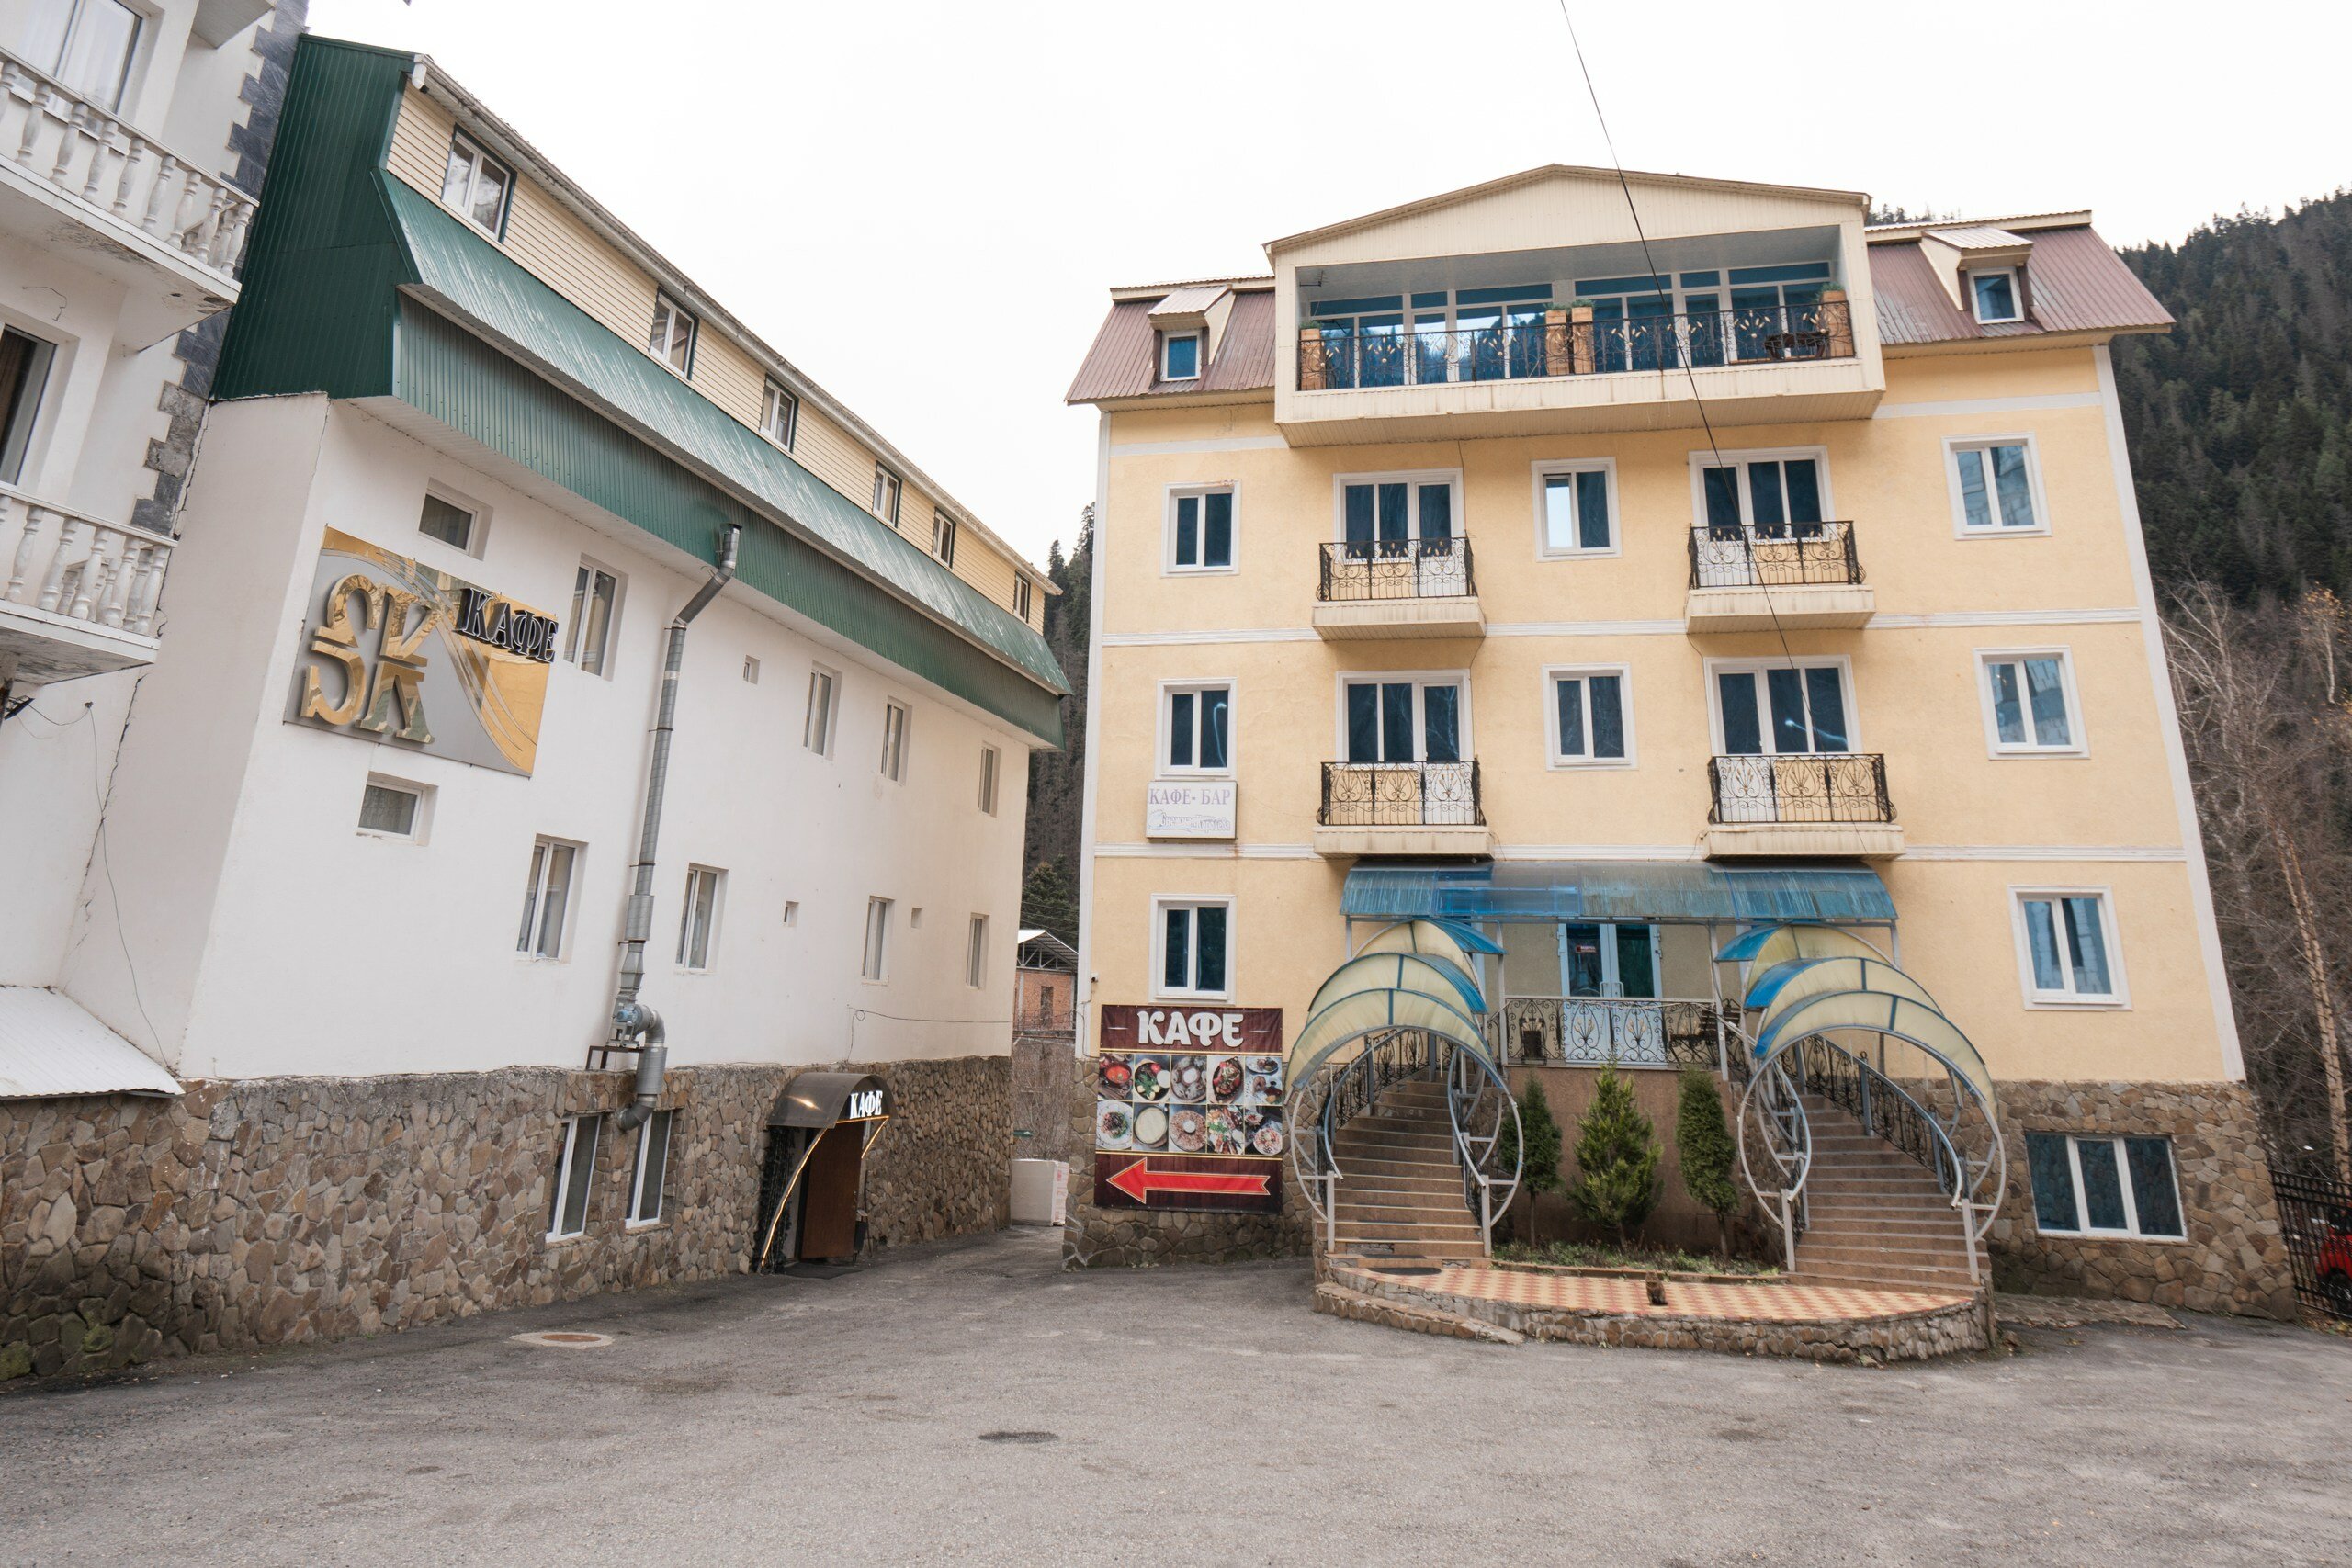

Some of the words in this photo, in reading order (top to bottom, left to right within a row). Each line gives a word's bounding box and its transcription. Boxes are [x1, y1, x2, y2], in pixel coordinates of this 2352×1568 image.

[458, 587, 559, 663] КАФЕ
[1201, 789, 1231, 806] БАР
[1137, 1010, 1244, 1047] КАФЕ
[849, 1089, 883, 1120] КАФЕ
